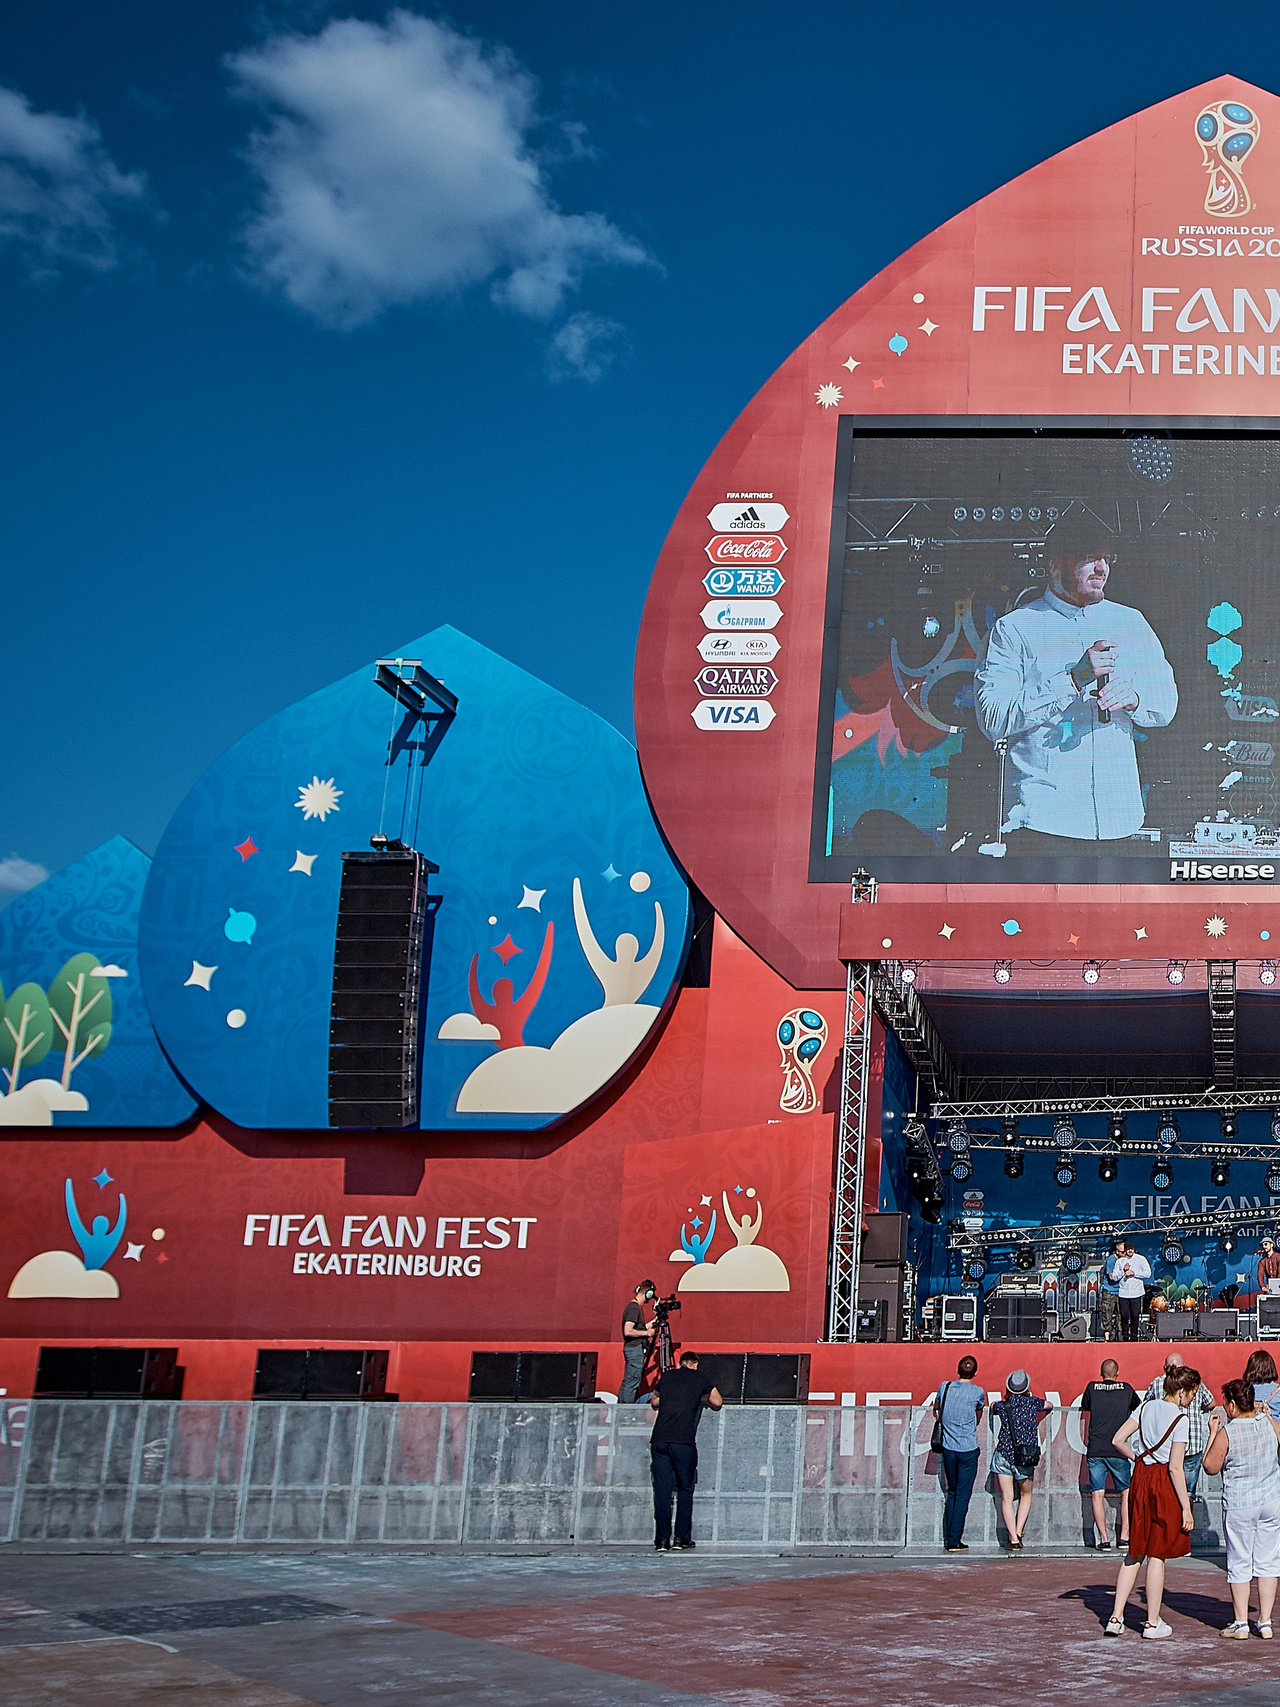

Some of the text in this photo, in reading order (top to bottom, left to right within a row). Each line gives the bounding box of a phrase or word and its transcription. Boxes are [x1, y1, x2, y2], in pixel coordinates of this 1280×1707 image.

[1178, 225, 1275, 236] FIFA WORLD CUP
[1141, 237, 1244, 256] RUSSIA
[972, 286, 1121, 332] FIFA
[729, 520, 766, 529] adidas
[736, 570, 776, 585] 万达
[736, 585, 774, 593] WANDA
[731, 617, 766, 627] GAZPROM
[702, 668, 768, 685] QATAR
[717, 684, 768, 695] AIRWAYS
[706, 706, 760, 724] VISA
[1170, 860, 1275, 879] Hisense
[244, 1214, 538, 1249] FIFA FAN FEST
[292, 1253, 482, 1277] EKATERINBURG
